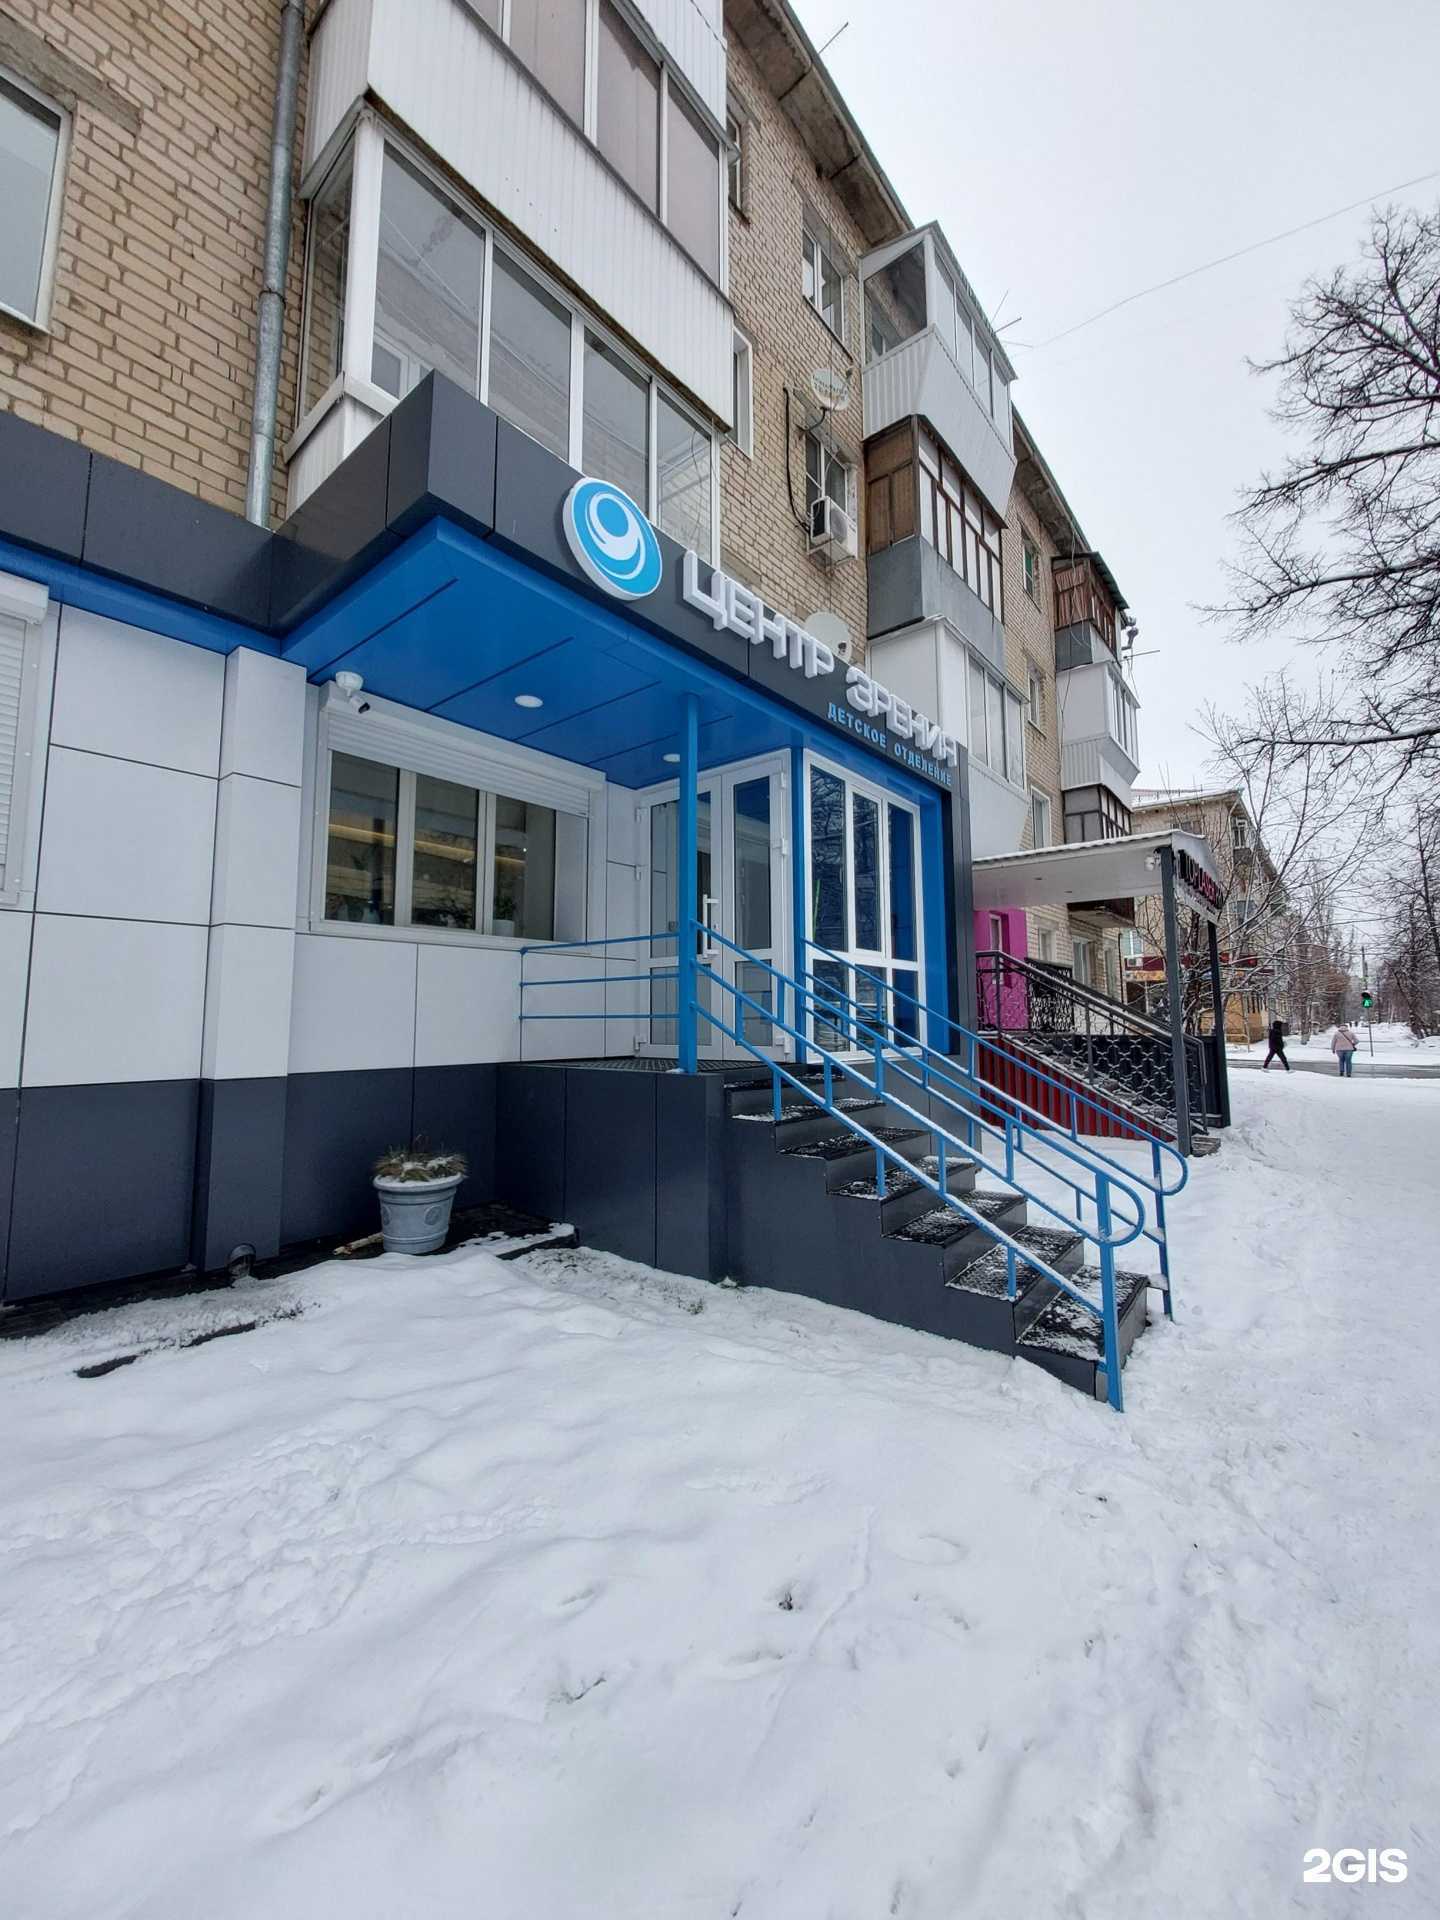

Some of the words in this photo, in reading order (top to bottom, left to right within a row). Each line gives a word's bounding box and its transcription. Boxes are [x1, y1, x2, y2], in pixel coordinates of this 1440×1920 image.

[683, 550, 835, 679] ЦЕНТР
[846, 666, 957, 767] ЗРЕНИЯ
[828, 702, 887, 749] ДЕТСКОЕ
[894, 743, 952, 786] ОТДЕЛЕНИЕ
